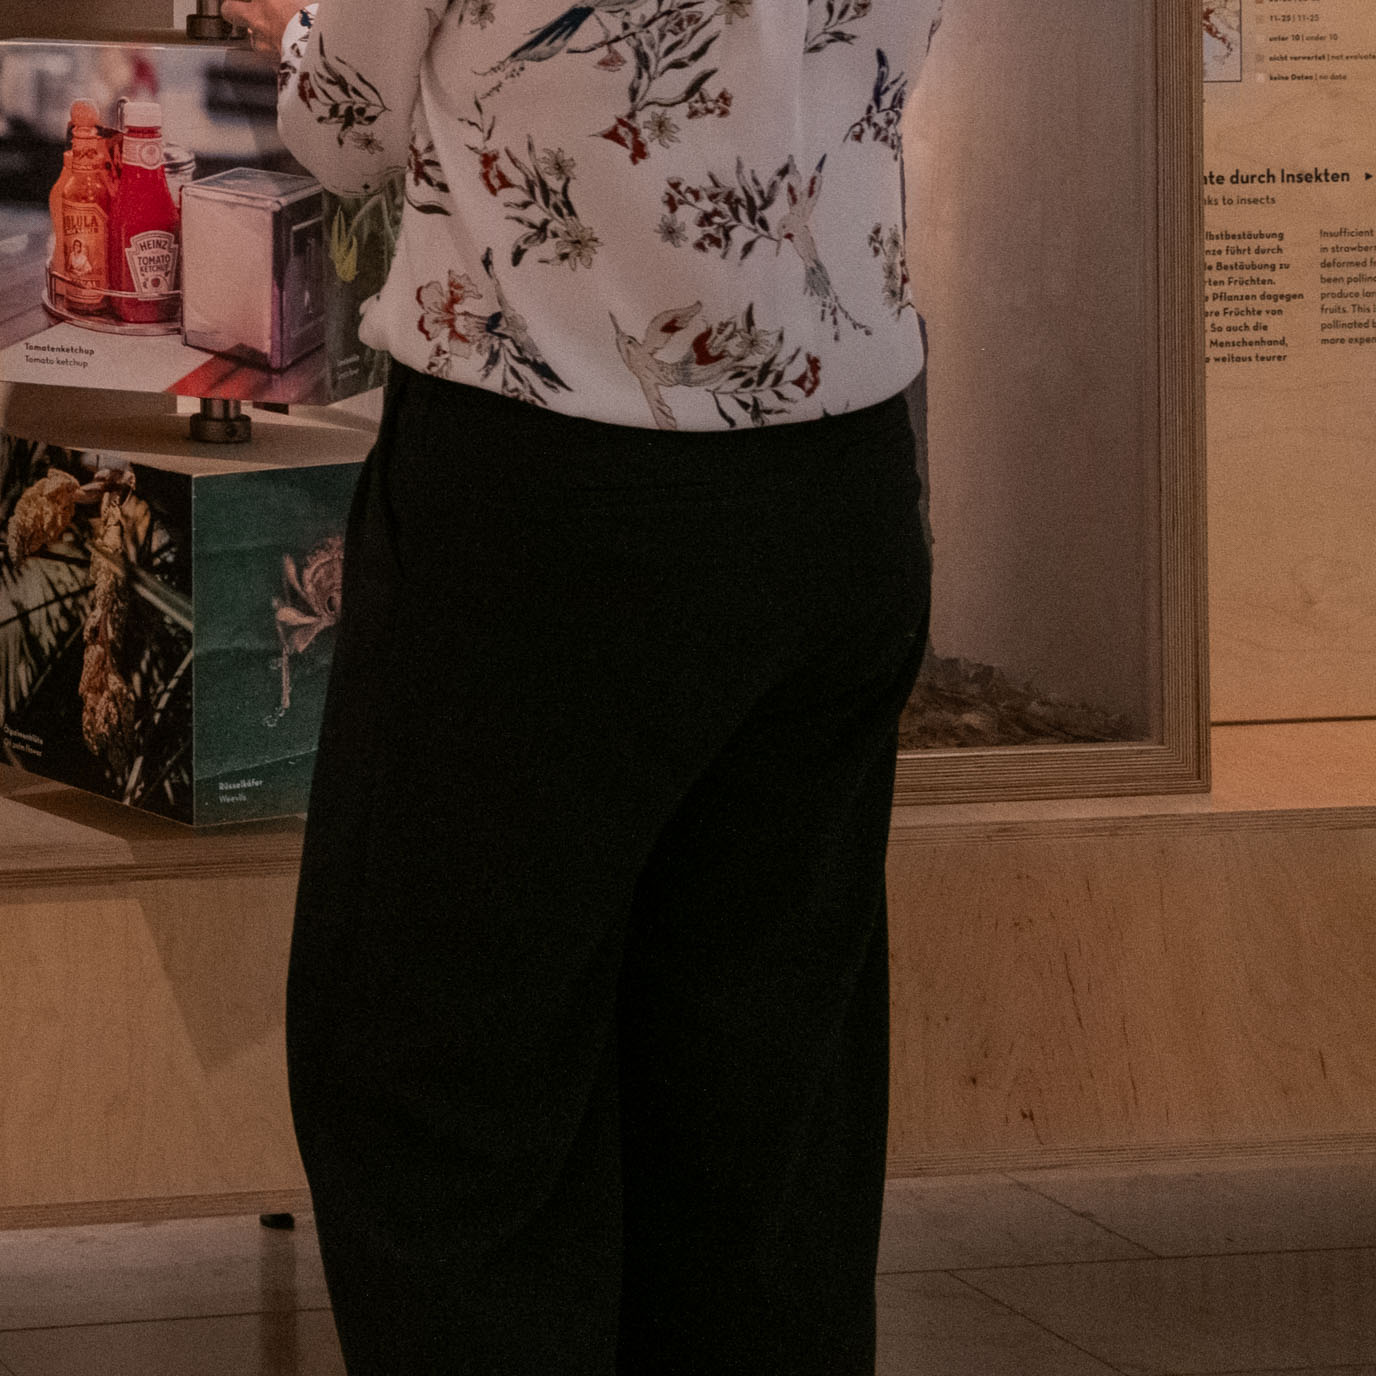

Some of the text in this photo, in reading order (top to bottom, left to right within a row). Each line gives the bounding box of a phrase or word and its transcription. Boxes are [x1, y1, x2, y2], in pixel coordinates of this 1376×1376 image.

[1229, 168, 1351, 184] durch Insekten
[1221, 196, 1276, 205] to insects
[139, 239, 168, 251] HEINZ
[137, 254, 171, 265] TOMATO
[1209, 337, 1289, 348] Menschenhand,
[25, 343, 95, 355] Tomatenketchup
[25, 355, 89, 367] Tomato ketchup
[1213, 354, 1253, 363] weitaus
